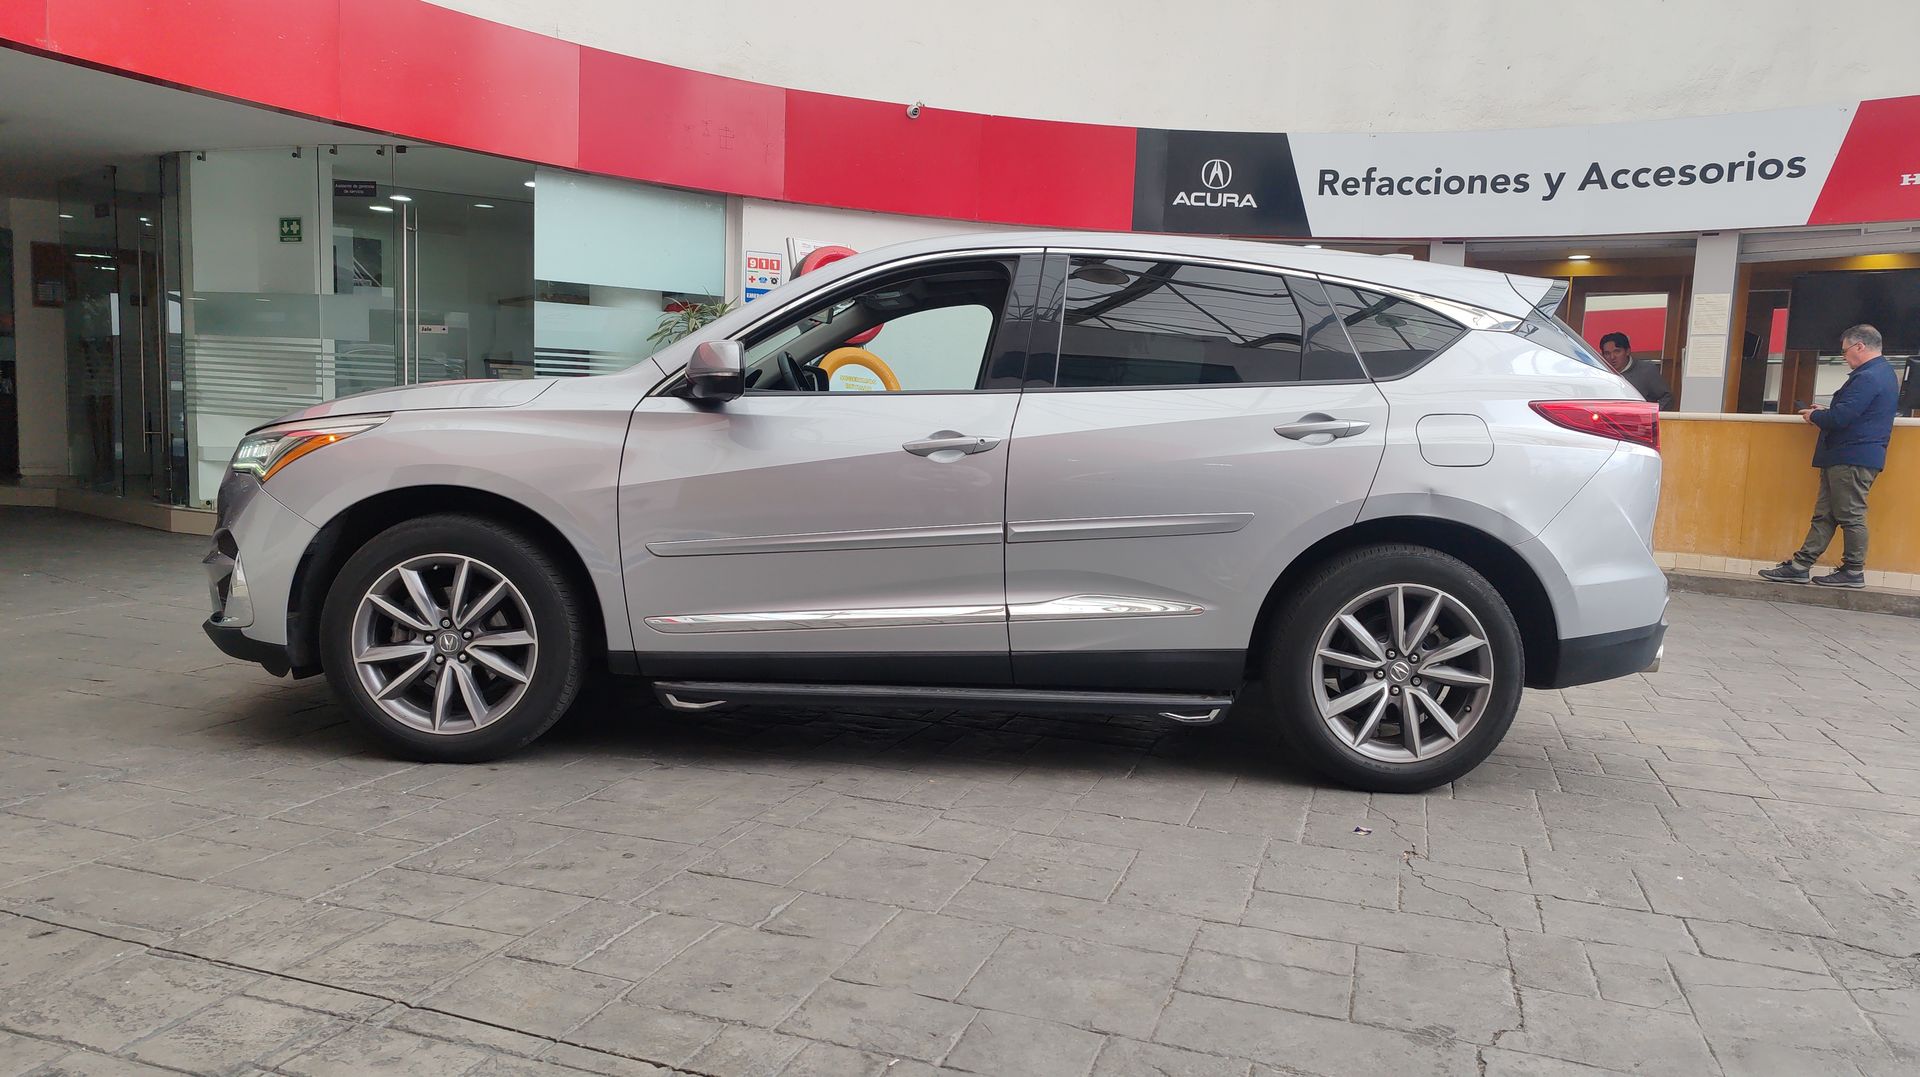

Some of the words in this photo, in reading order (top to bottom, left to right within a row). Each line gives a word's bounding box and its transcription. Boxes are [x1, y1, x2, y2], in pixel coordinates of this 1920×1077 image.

[1318, 166, 1530, 197] Refacciones
[1542, 171, 1566, 201] y
[1577, 151, 1807, 191] Accesorios
[1172, 191, 1258, 209] ACURA
[749, 258, 778, 270] 911
